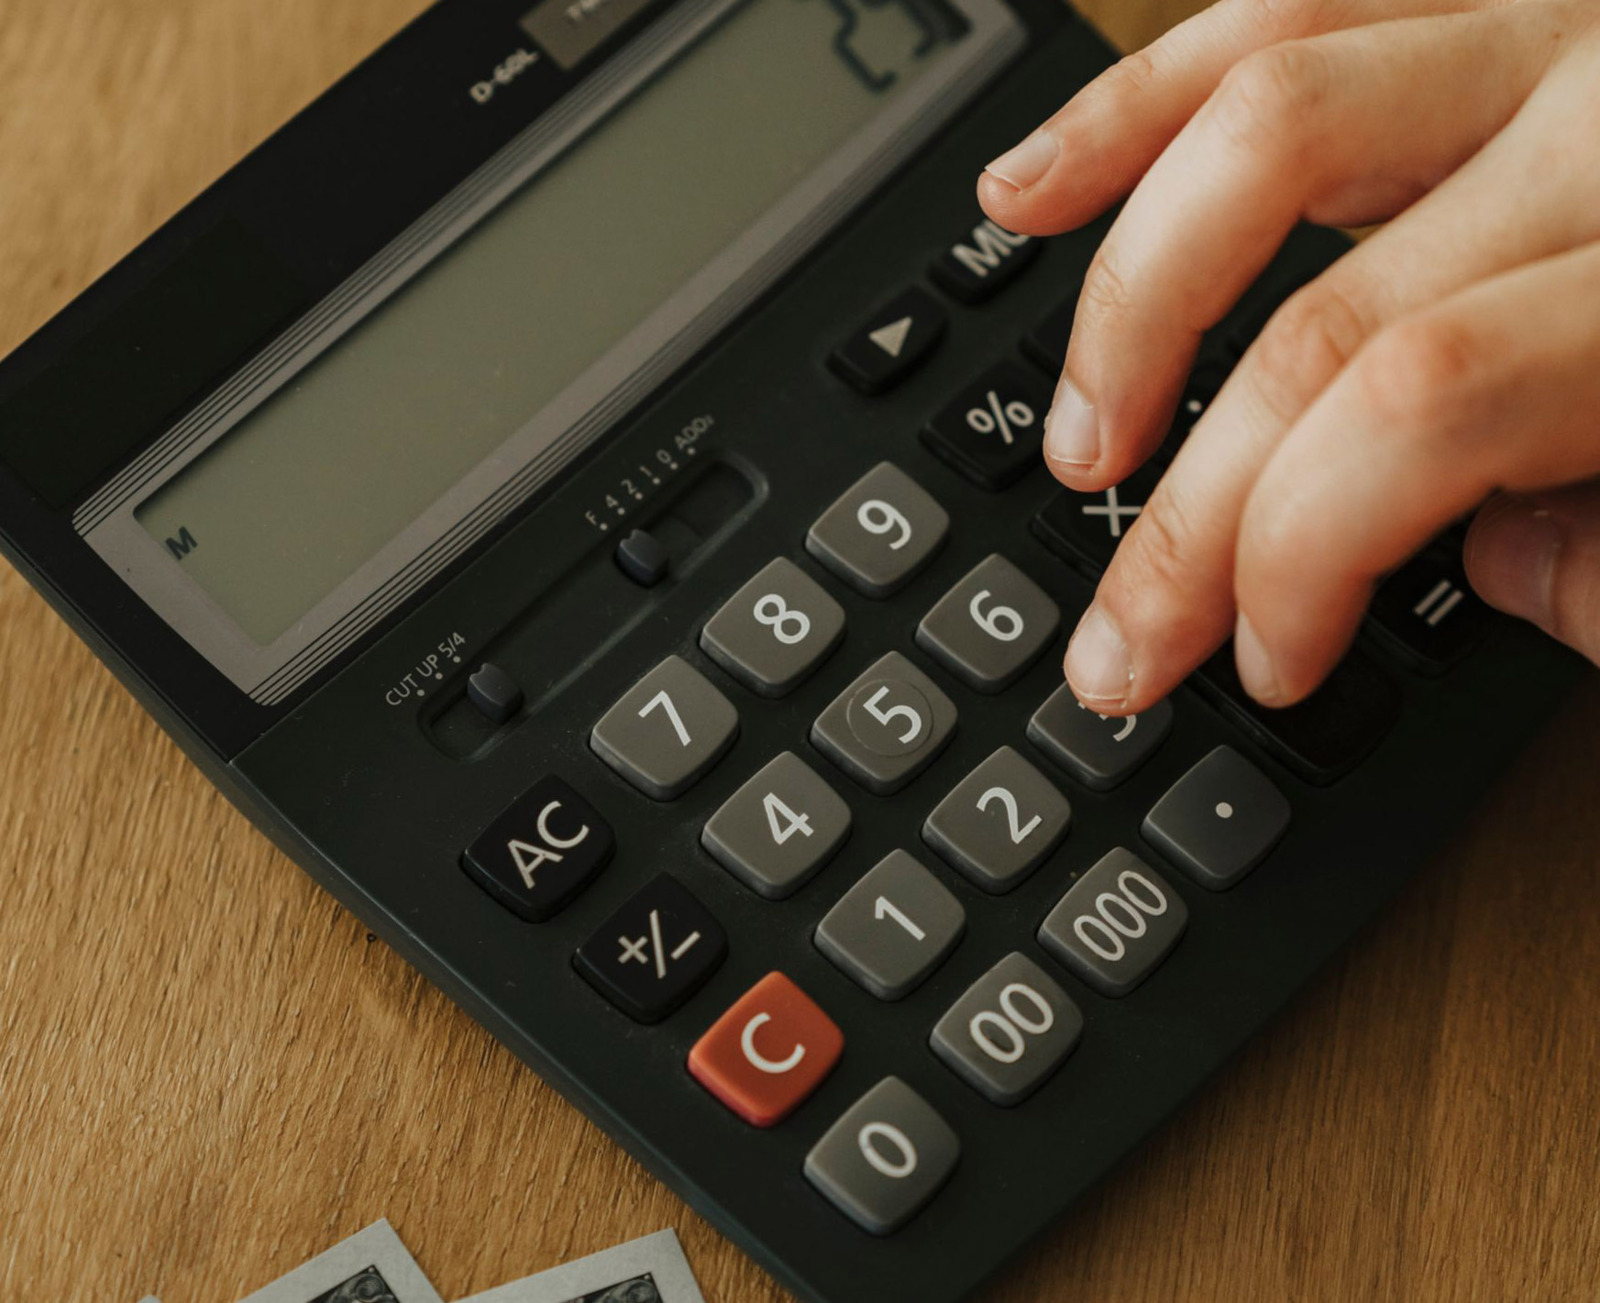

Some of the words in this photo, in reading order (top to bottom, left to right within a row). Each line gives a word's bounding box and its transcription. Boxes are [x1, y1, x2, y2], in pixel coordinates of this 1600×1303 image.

[606, 495, 618, 507] 4
[621, 480, 638, 494] 2
[640, 466, 652, 477] 1
[165, 526, 198, 560] M
[857, 499, 912, 550] 9
[753, 593, 811, 644] 8
[969, 589, 1024, 642] 6
[385, 674, 415, 706] CUT
[416, 654, 441, 679] UP
[438, 632, 466, 660] 5/4
[638, 690, 692, 747] 7
[862, 685, 922, 744] 5
[762, 792, 814, 845] 4
[976, 786, 1042, 844] 2
[507, 800, 589, 889] AC
[874, 895, 926, 941] 1
[1072, 869, 1168, 961] 000
[741, 1012, 805, 1073] C
[969, 983, 1054, 1063] 00
[858, 1122, 916, 1177] 0
